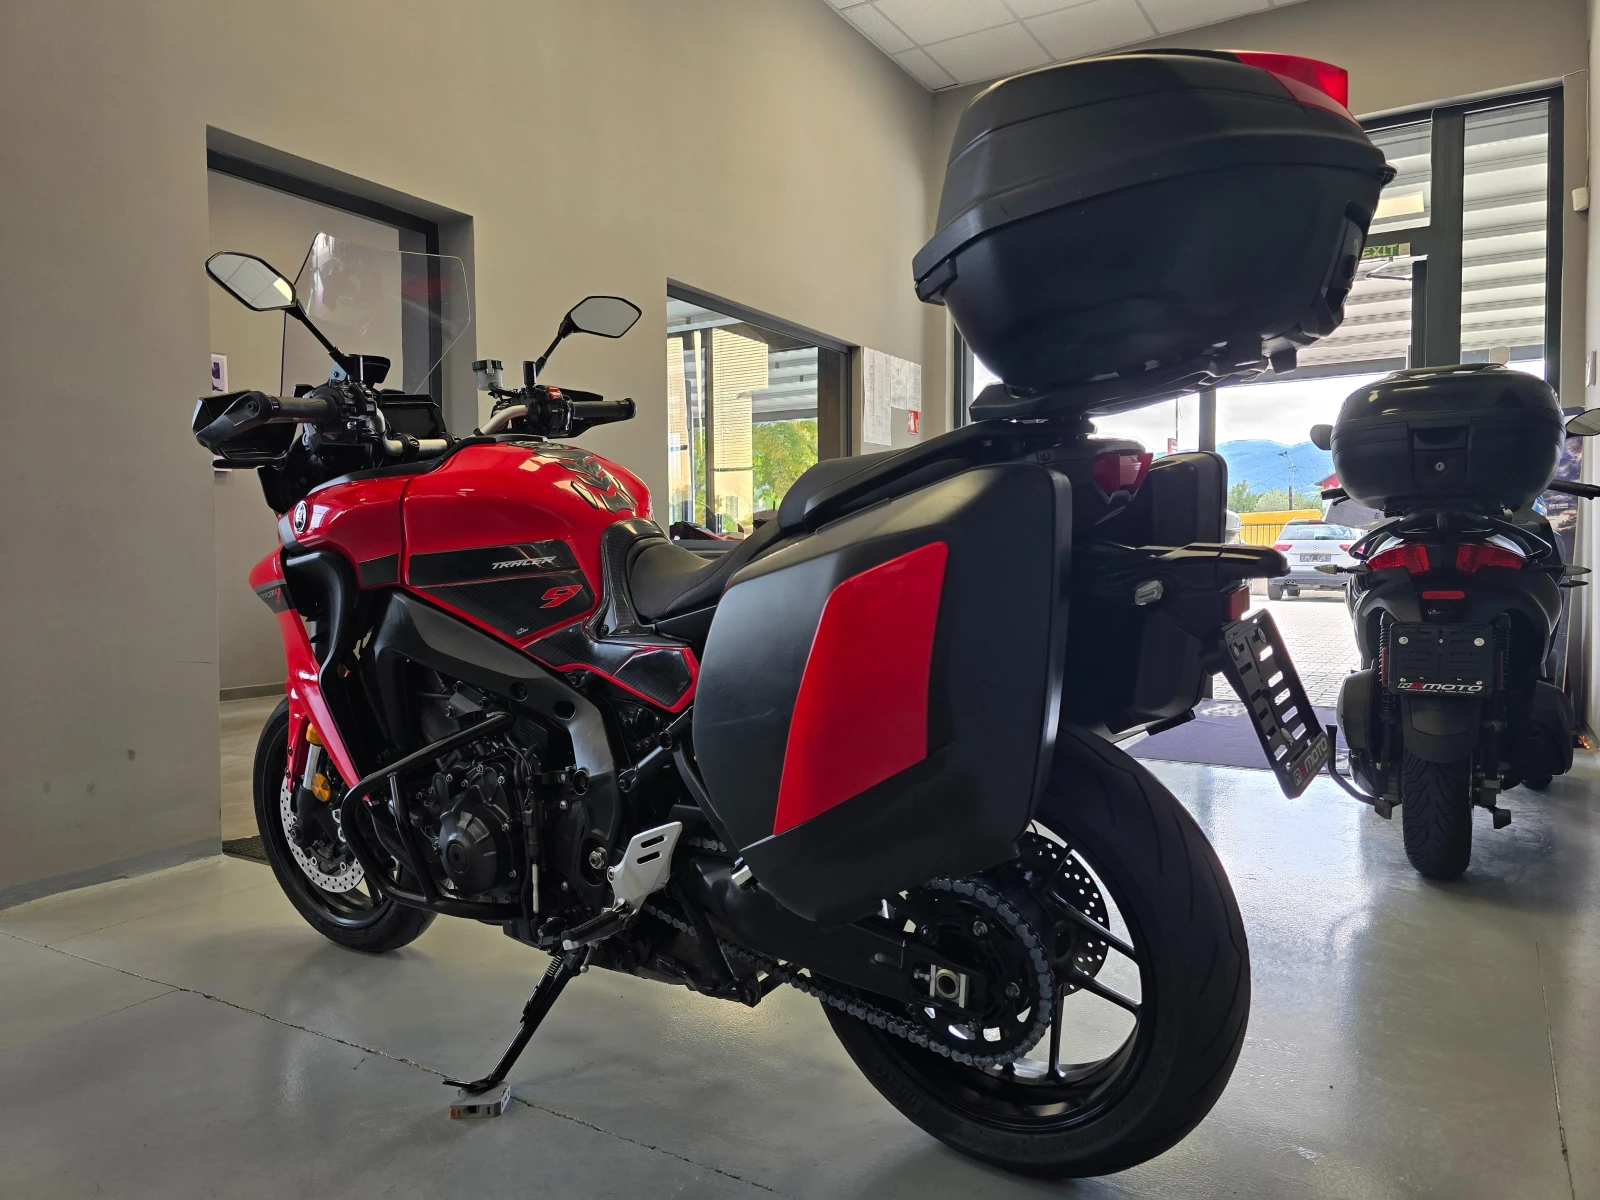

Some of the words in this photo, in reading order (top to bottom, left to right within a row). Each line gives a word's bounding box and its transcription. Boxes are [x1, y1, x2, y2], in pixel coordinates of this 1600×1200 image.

[1361, 244, 1398, 259] EXIT
[492, 555, 557, 570] TRACER
[540, 584, 583, 609] 9
